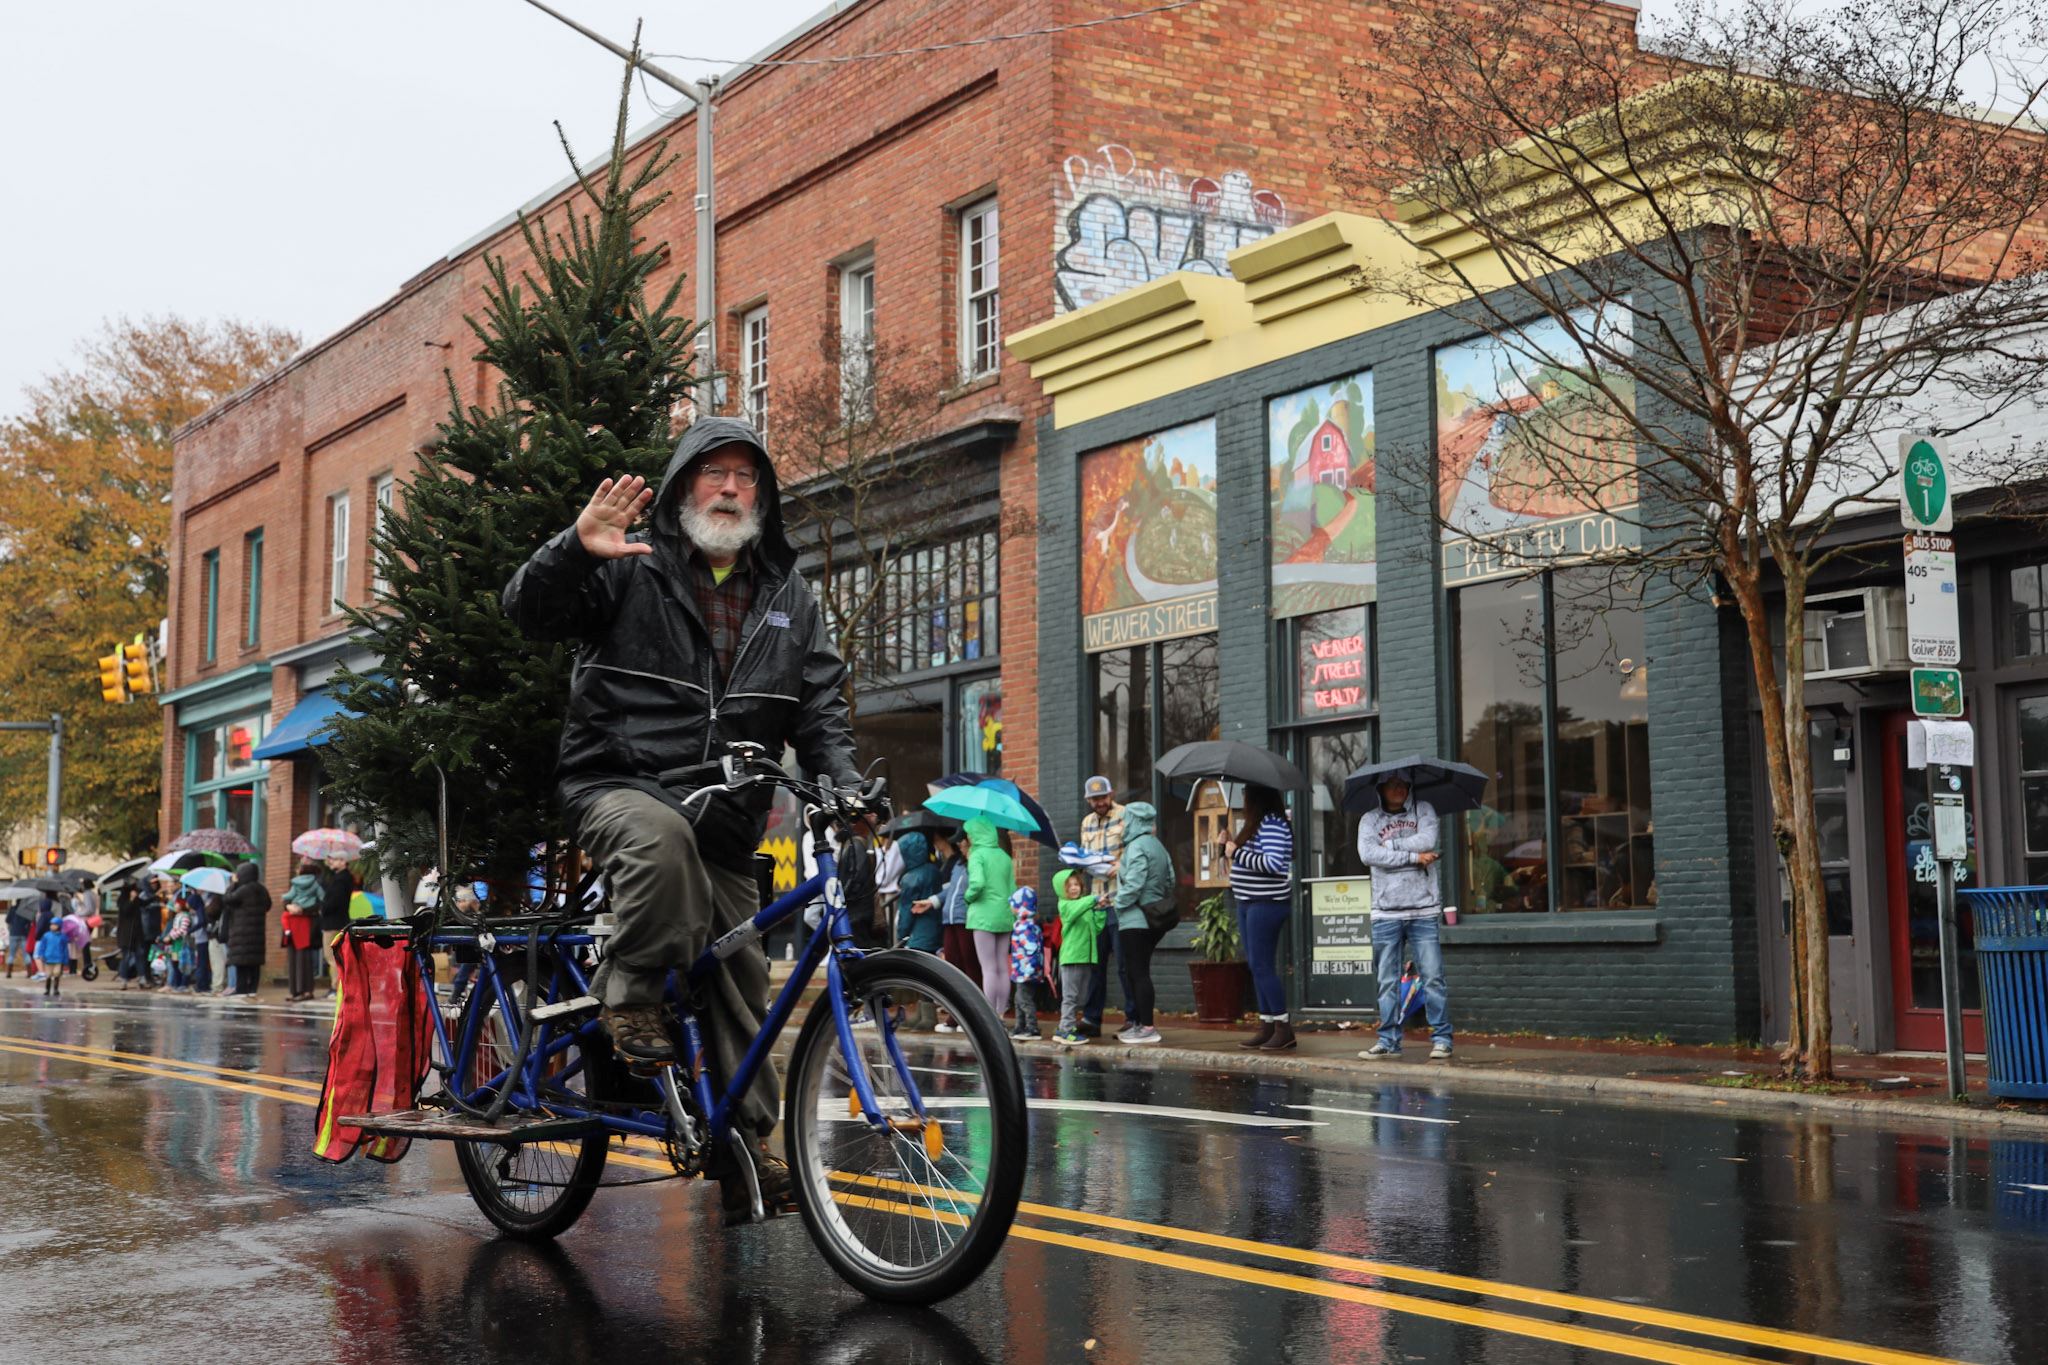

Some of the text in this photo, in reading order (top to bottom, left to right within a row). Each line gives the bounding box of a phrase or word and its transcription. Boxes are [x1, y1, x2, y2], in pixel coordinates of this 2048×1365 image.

[1922, 488, 1929, 517] 1
[1465, 516, 1624, 577] REALTY CO.
[1912, 535, 1952, 551] BUS STOP
[1907, 565, 1928, 577] 405
[1909, 592, 1915, 605] J
[1087, 597, 1217, 647] WEAVER STREET
[1311, 635, 1363, 659] WEAVER
[1311, 659, 1361, 685] STREET
[1314, 686, 1361, 708] REALTY
[1342, 895, 1359, 905] Open
[1322, 915, 1364, 925] Call or Email
[1317, 934, 1371, 945] Real Estate Needs
[1330, 961, 1352, 974] EAST
[1353, 961, 1373, 974] MAI
